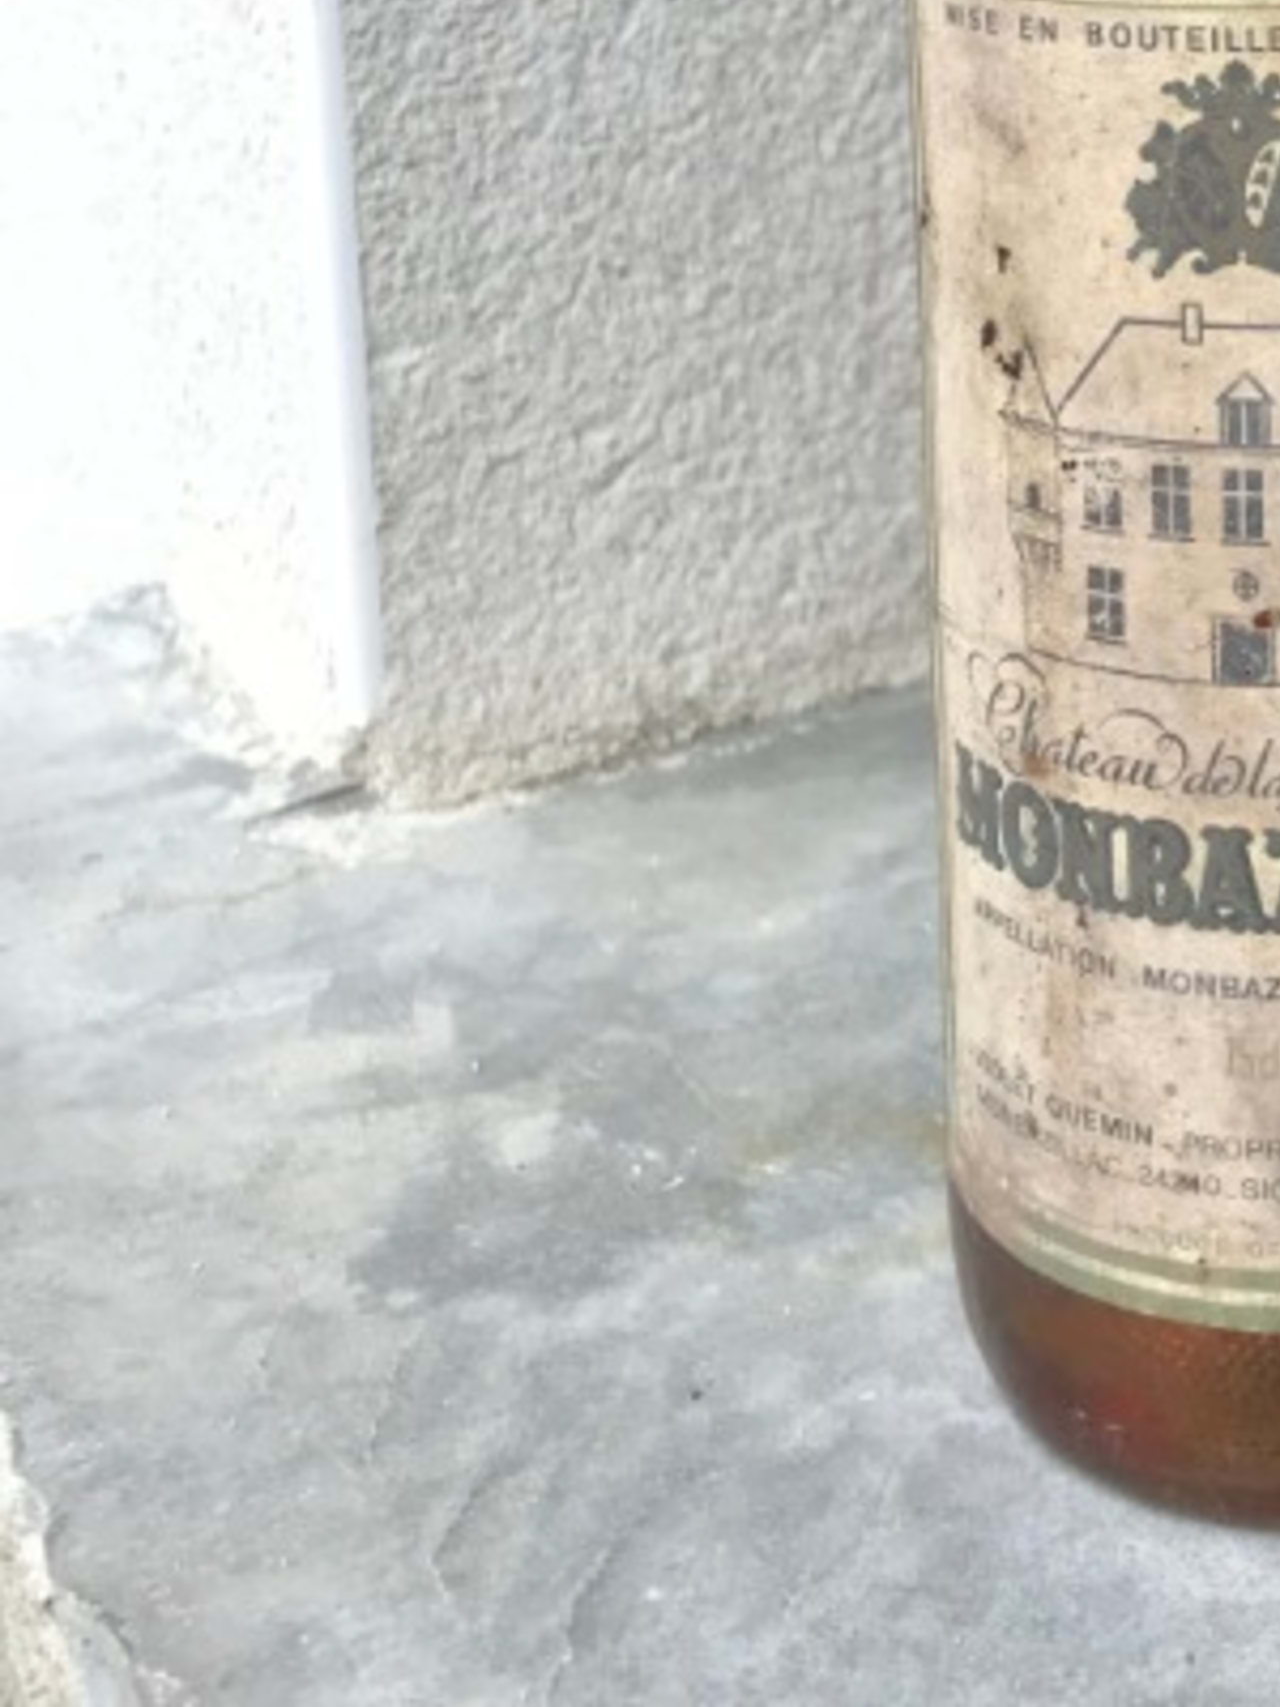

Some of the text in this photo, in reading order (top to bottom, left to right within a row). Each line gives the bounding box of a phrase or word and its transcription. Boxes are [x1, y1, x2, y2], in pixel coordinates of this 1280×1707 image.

[945, 3, 999, 36] MISE
[1018, 14, 1059, 43] EN
[1044, 1093, 1154, 1147] QUEMIN
